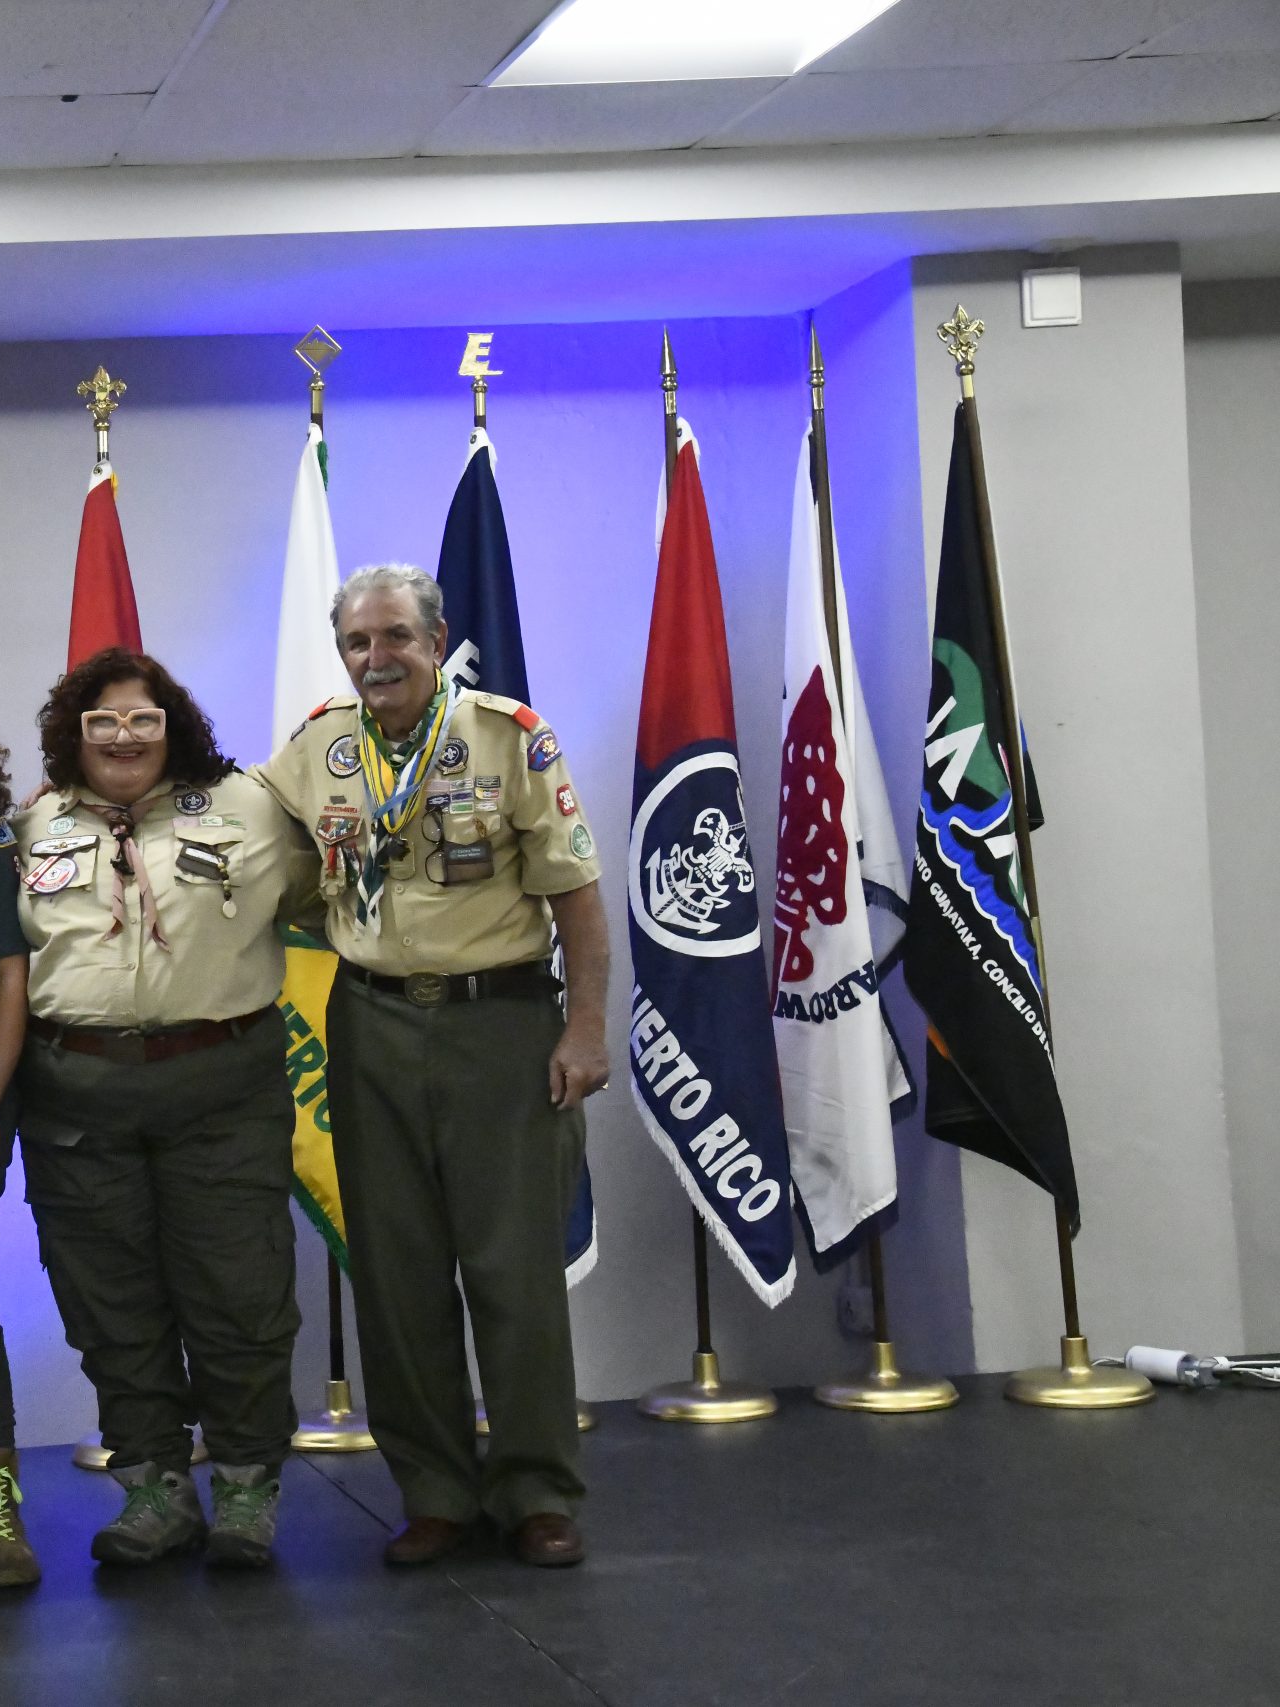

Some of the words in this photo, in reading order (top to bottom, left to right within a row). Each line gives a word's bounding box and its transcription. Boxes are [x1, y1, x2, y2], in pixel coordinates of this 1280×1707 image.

[458, 332, 504, 376] E
[774, 960, 879, 1024] ARROW
[929, 881, 982, 961] GUAJATAKA,
[982, 959, 1037, 1024] CONCILIO
[631, 983, 712, 1121] UERTO
[688, 1112, 781, 1222] RICO
